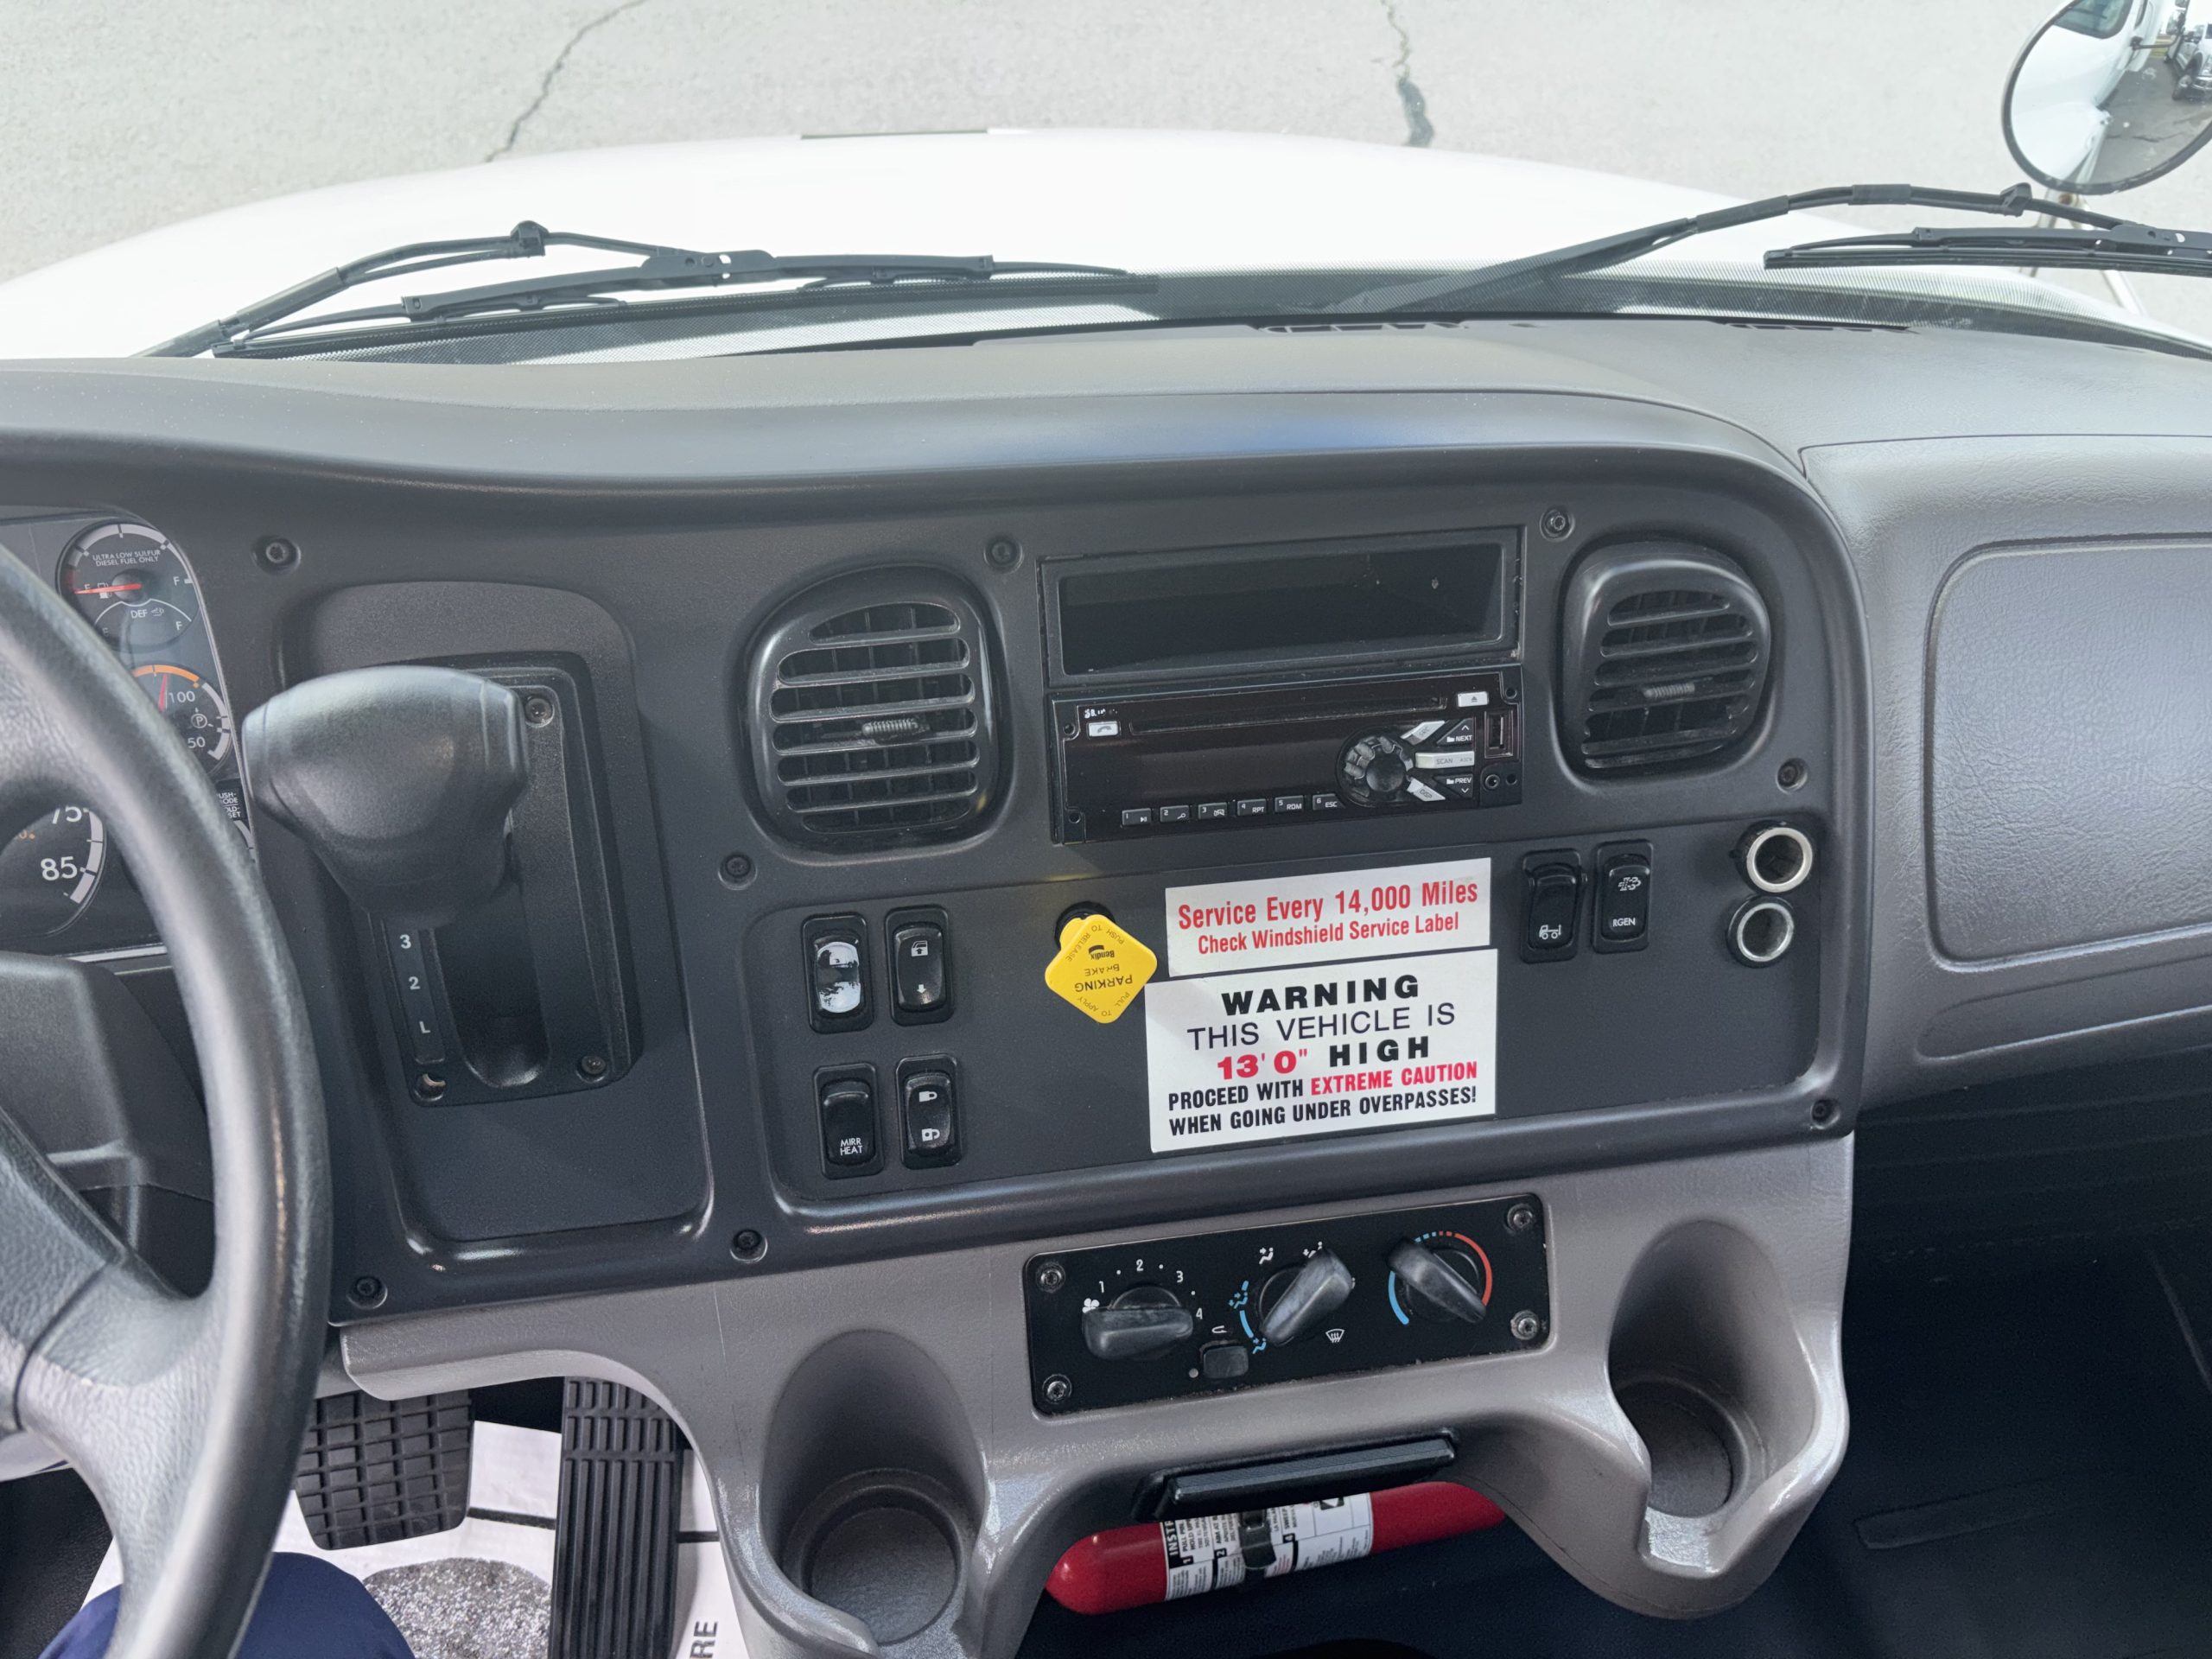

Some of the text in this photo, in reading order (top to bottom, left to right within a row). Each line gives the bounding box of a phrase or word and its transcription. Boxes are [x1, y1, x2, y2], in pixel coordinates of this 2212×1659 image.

[92, 552, 114, 561] ULTRA
[134, 549, 161, 557] SULFUR
[96, 558, 119, 567] DIESEL
[120, 556, 137, 565] FUEL
[173, 576, 180, 586] F
[130, 609, 148, 619] DEF
[175, 621, 183, 631] F
[168, 691, 196, 703] 100
[187, 736, 206, 748] 50
[219, 791, 237, 800] USH-
[1419, 788, 1433, 798] DISP
[222, 796, 238, 804] ODE
[40, 856, 78, 881] 85
[1178, 880, 1478, 930] Service Every 14,000 Miles
[1612, 916, 1636, 927] RGEN
[1106, 928, 1124, 944] PUSH
[1198, 911, 1459, 955] Check Windshield Service Label
[399, 934, 411, 949] 3
[1065, 932, 1090, 962] RELEASE
[1090, 950, 1115, 960] Bendix
[409, 976, 420, 990] 2
[1074, 975, 1133, 993] PARKING
[1114, 991, 1131, 1007] PULL
[1221, 974, 1419, 1016] WARNING
[1077, 995, 1099, 1012] APPLY
[419, 1020, 431, 1033] L
[1186, 1002, 1455, 1051] THIS VEHICLE IS
[1329, 1035, 1428, 1067] HIGH
[1168, 1060, 1477, 1111] PROCEED WITH EXTREME CAUTION
[1169, 1085, 1477, 1136] WHEN GOING UNDER OVERPASSES!
[840, 1138, 862, 1147] MIRR
[840, 1146, 863, 1156] HEAT
[1136, 1259, 1143, 1272] 2
[1176, 1270, 1184, 1283] 3
[1098, 1281, 1104, 1293] 1
[1196, 1307, 1203, 1319] 4
